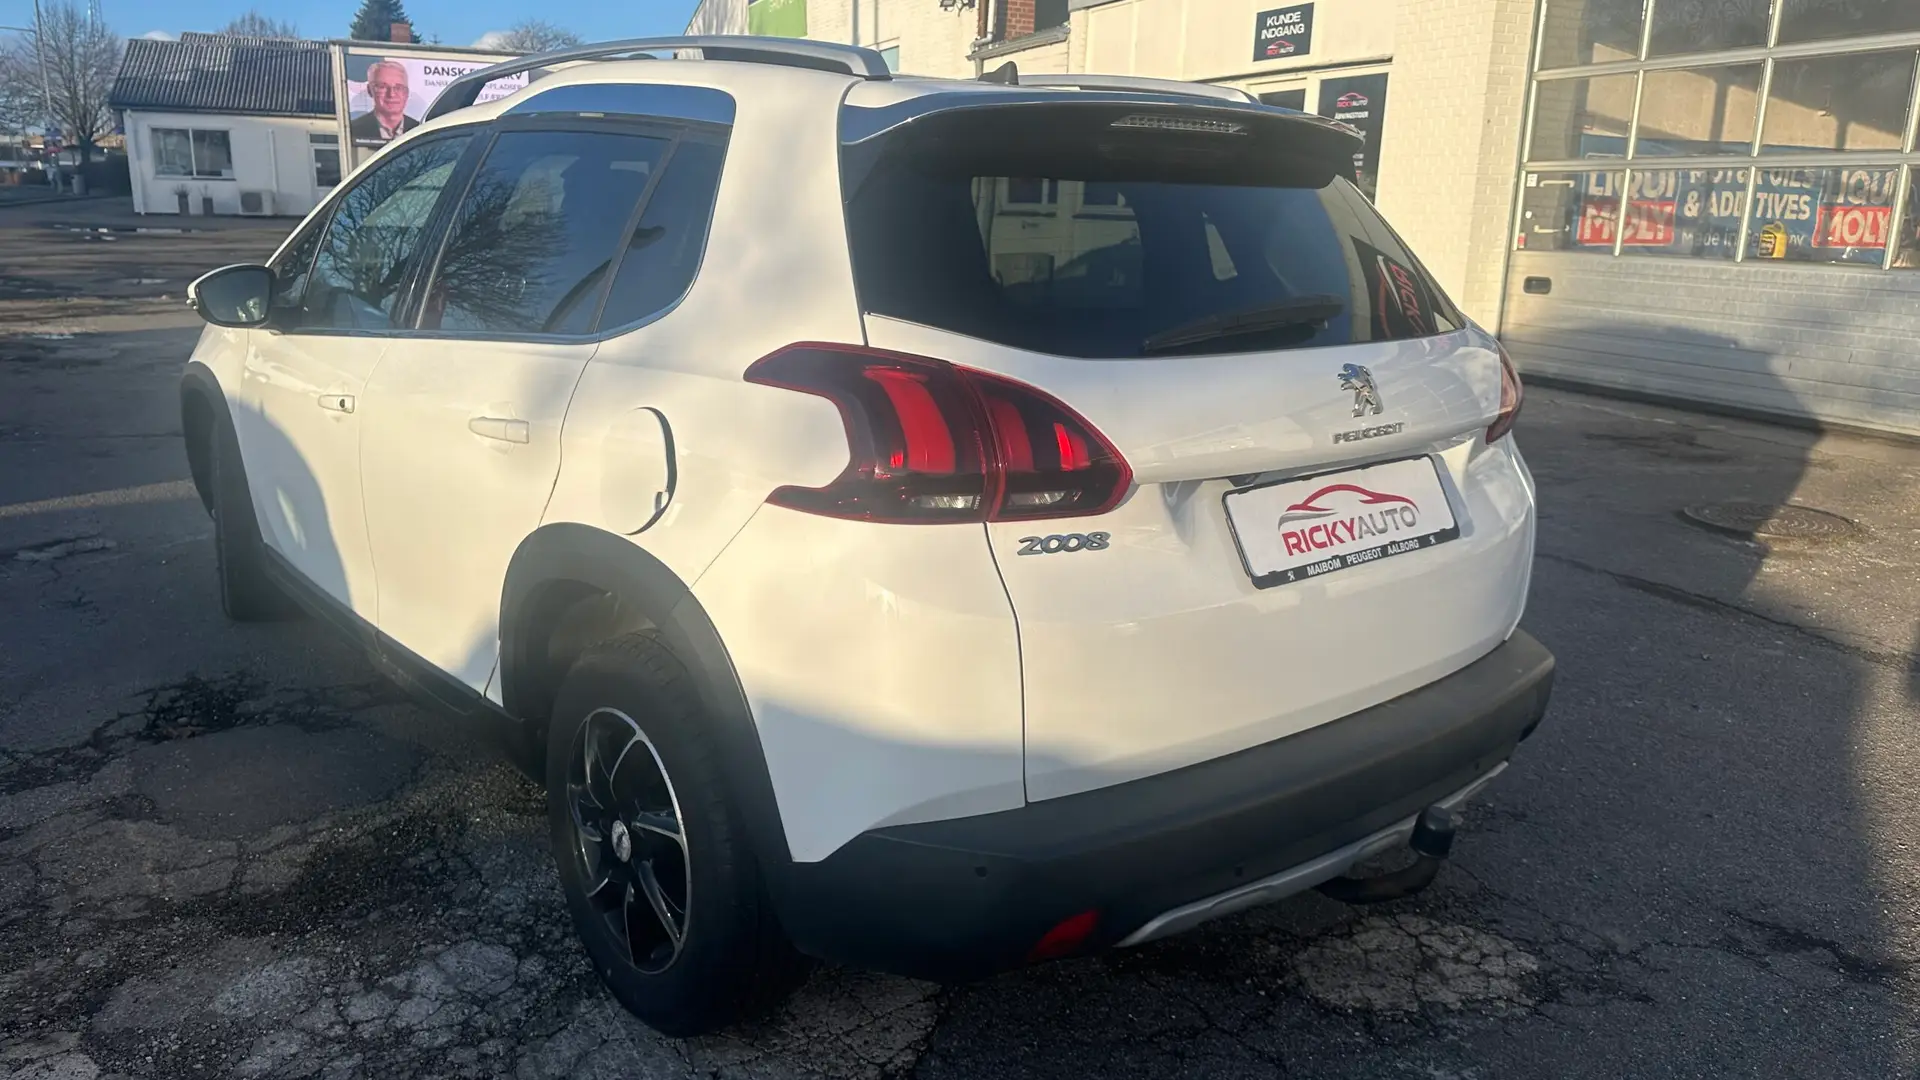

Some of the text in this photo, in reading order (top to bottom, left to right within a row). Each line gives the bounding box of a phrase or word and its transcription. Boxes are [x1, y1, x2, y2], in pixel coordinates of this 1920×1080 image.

[1260, 23, 1305, 40] INDGANG
[1266, 11, 1301, 27] KUNDE
[423, 65, 467, 77] DANSK
[1587, 170, 1676, 200] LIQUI
[1683, 190, 1812, 221] & ADDTIVES
[1583, 204, 1675, 241] MOLY
[1817, 209, 1891, 245] MOLY
[1332, 421, 1405, 445] PEUGEOT
[1016, 531, 1112, 556] 2008
[1281, 505, 1418, 557] RICKYAUTO
[1306, 539, 1420, 577] MAIBOM PEUGEOT AALBORG
